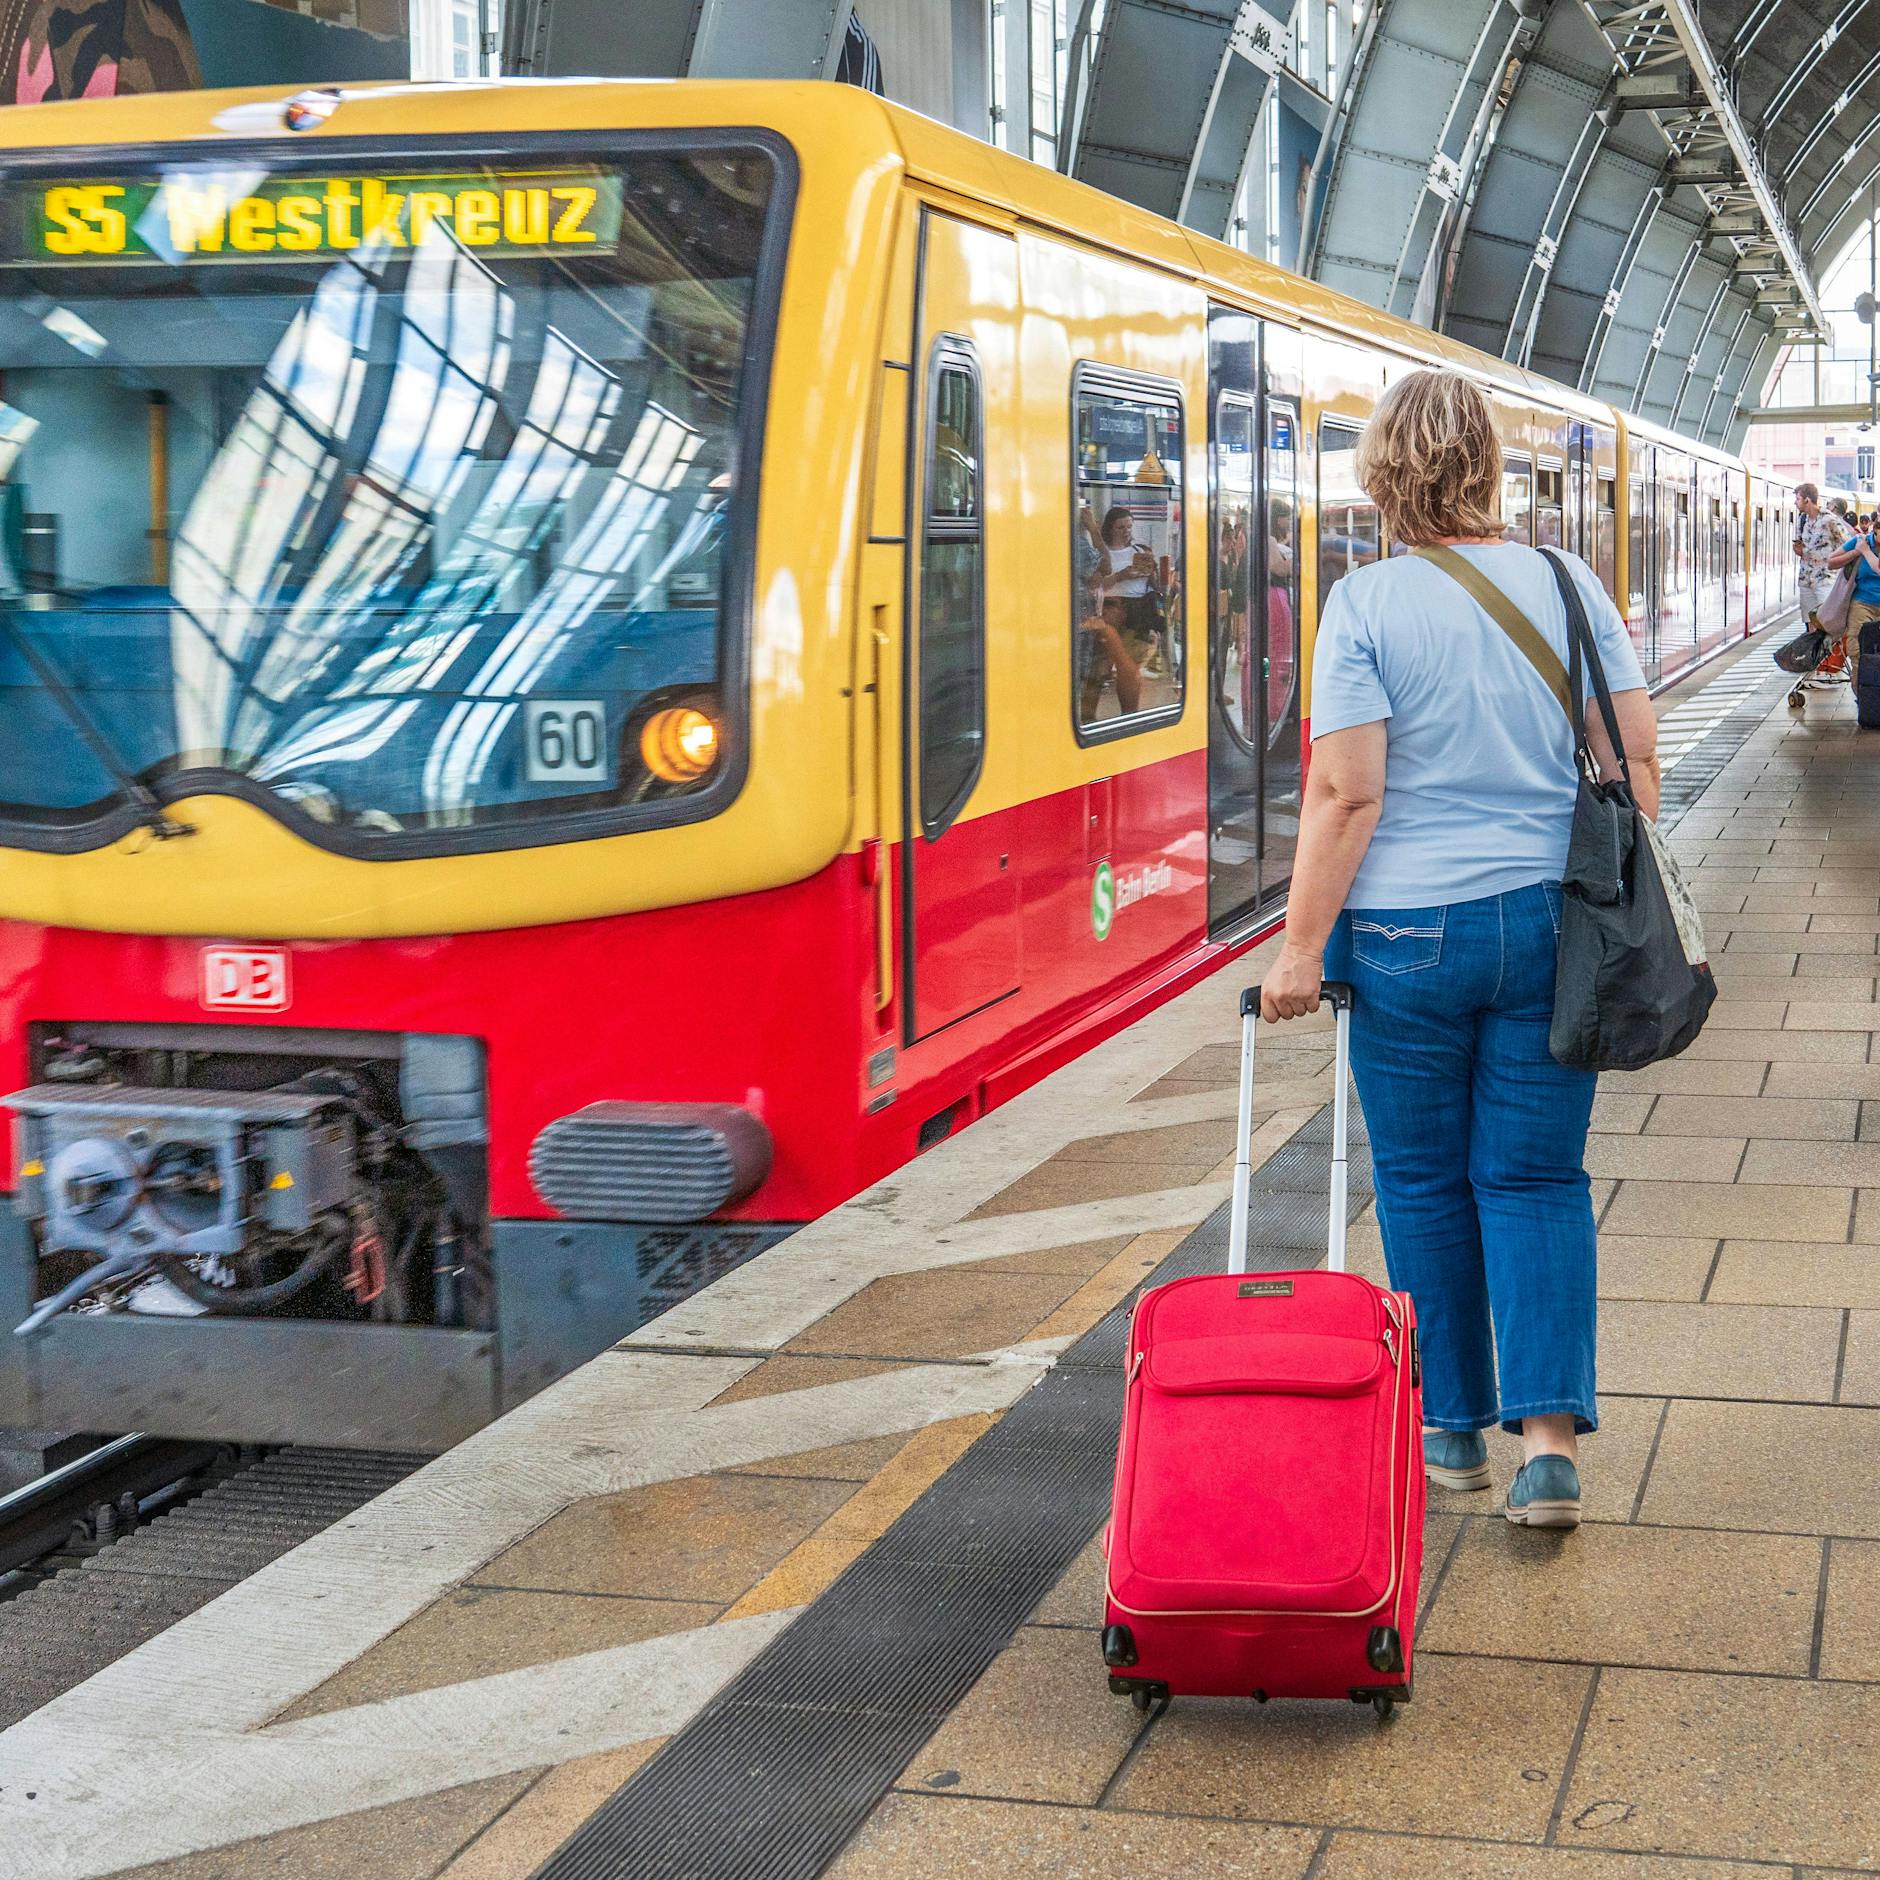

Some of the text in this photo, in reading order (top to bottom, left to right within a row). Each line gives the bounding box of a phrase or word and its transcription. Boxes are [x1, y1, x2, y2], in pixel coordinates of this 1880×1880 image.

[45, 178, 597, 255] S5 Westkreuz
[538, 710, 596, 770] 60
[1095, 870, 1113, 933] S
[1142, 859, 1172, 898] Berlin
[208, 954, 281, 1002] DB
